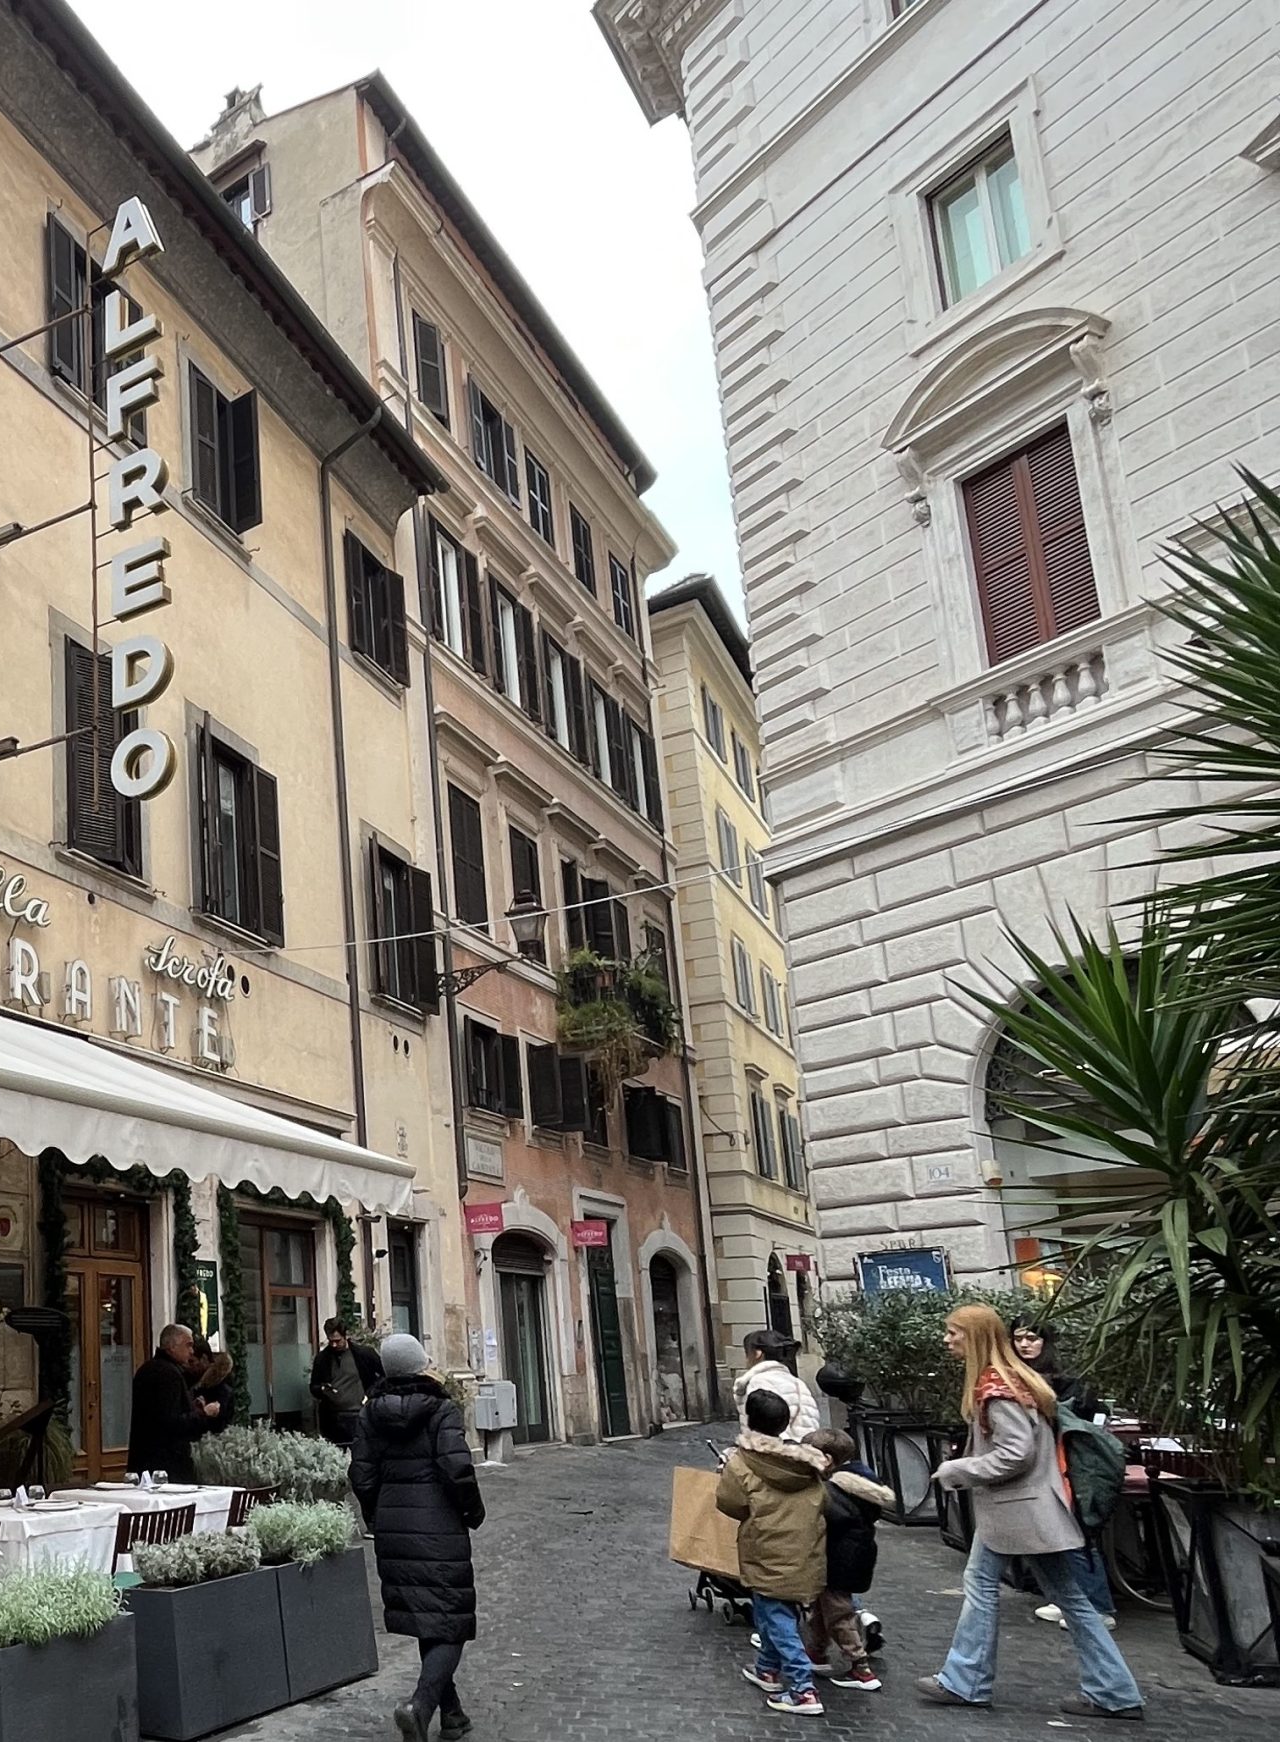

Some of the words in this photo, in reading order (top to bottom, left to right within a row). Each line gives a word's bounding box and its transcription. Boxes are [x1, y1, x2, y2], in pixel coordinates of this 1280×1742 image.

[101, 195, 177, 799] ALFREDO
[145, 935, 235, 1001] Scrofa
[929, 1167, 950, 1180] 104
